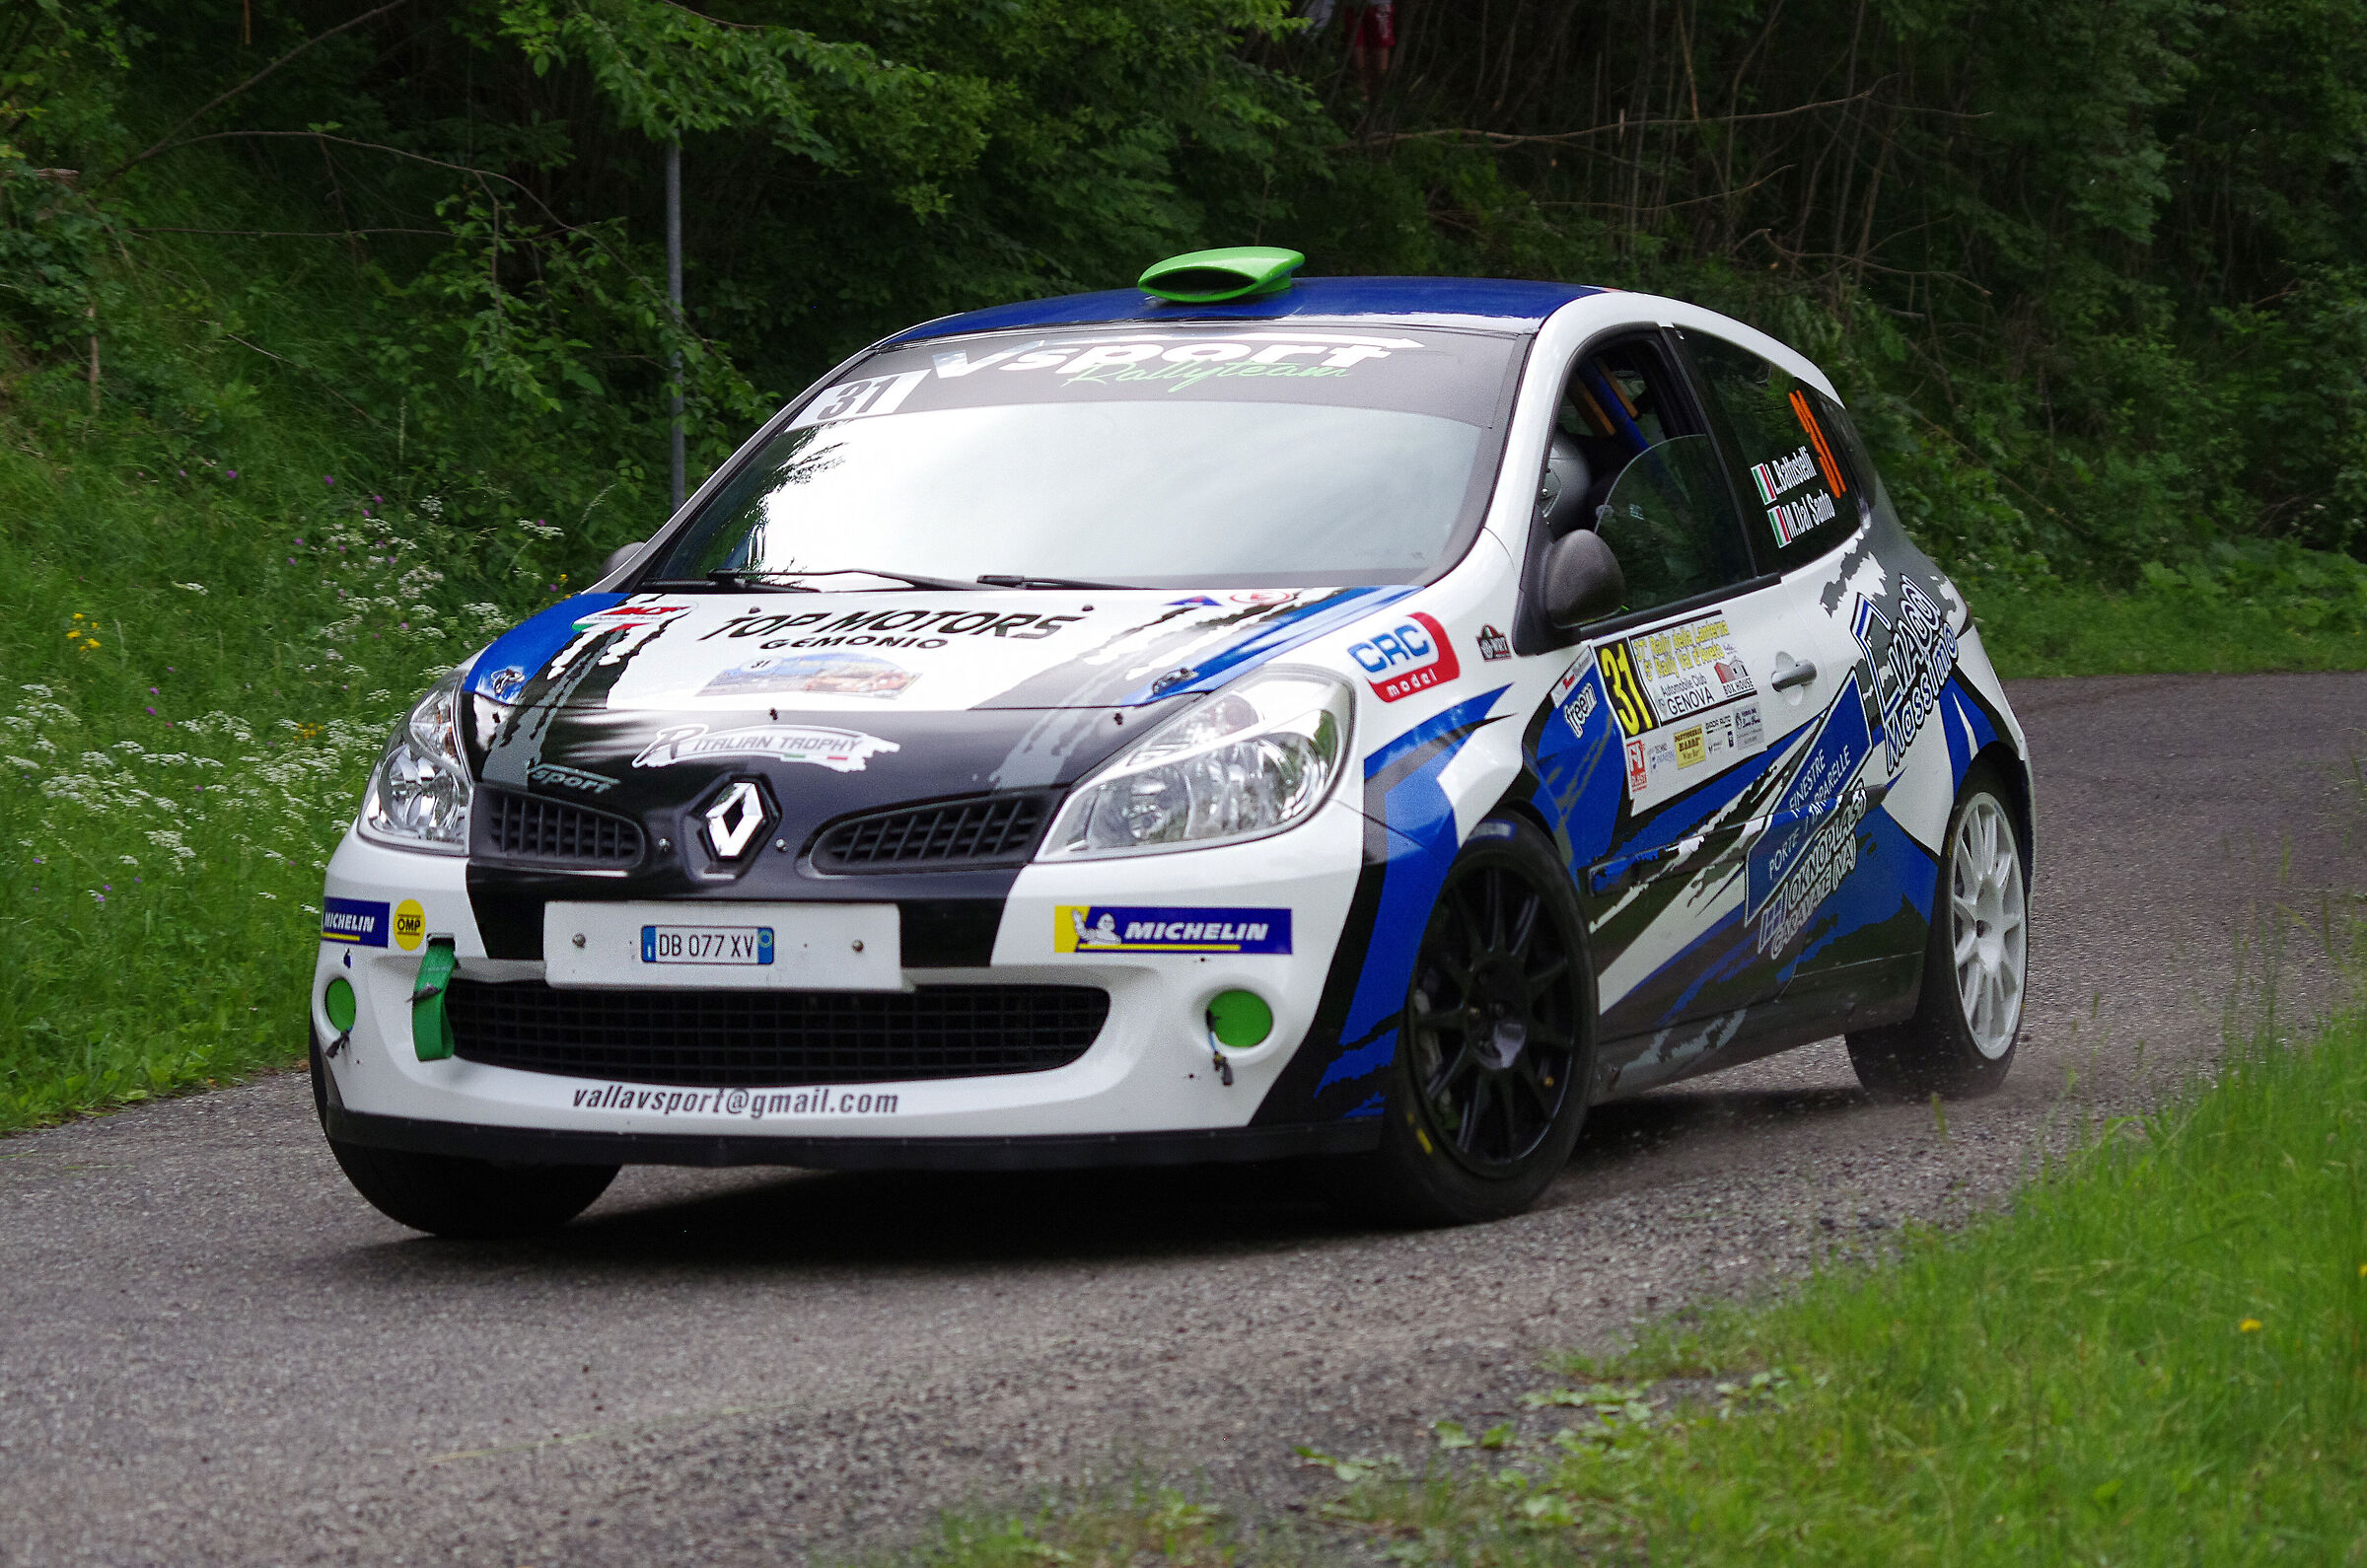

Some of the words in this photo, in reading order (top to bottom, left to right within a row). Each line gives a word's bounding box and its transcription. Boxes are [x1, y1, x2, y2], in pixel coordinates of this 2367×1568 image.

[821, 379, 886, 419] 31
[697, 609, 828, 641] TOP
[807, 609, 1088, 639] MOTORS
[760, 635, 948, 650] GEMONIO
[1347, 623, 1431, 674] CRC
[1648, 632, 1672, 657] Rally
[1654, 653, 1681, 678] Rally
[1386, 668, 1438, 697] model
[1600, 642, 1654, 737] 31
[1660, 676, 1694, 697] Automobile
[1690, 672, 1707, 688] Club
[1667, 687, 1716, 716] GENOVA
[1884, 622, 1959, 777] Massimo
[693, 735, 775, 752] ITALIAN
[780, 736, 865, 752] TROPHY
[1788, 748, 1828, 819] FINESTRE
[1768, 826, 1801, 881] PORTE
[323, 911, 376, 933] MICHELIN
[396, 918, 421, 932] OMP
[1123, 921, 1269, 943] MICHELIN
[658, 934, 682, 957] DB
[688, 934, 725, 958] 077
[731, 935, 754, 958] XV
[572, 1085, 898, 1117] vallavsport@gmail.com
